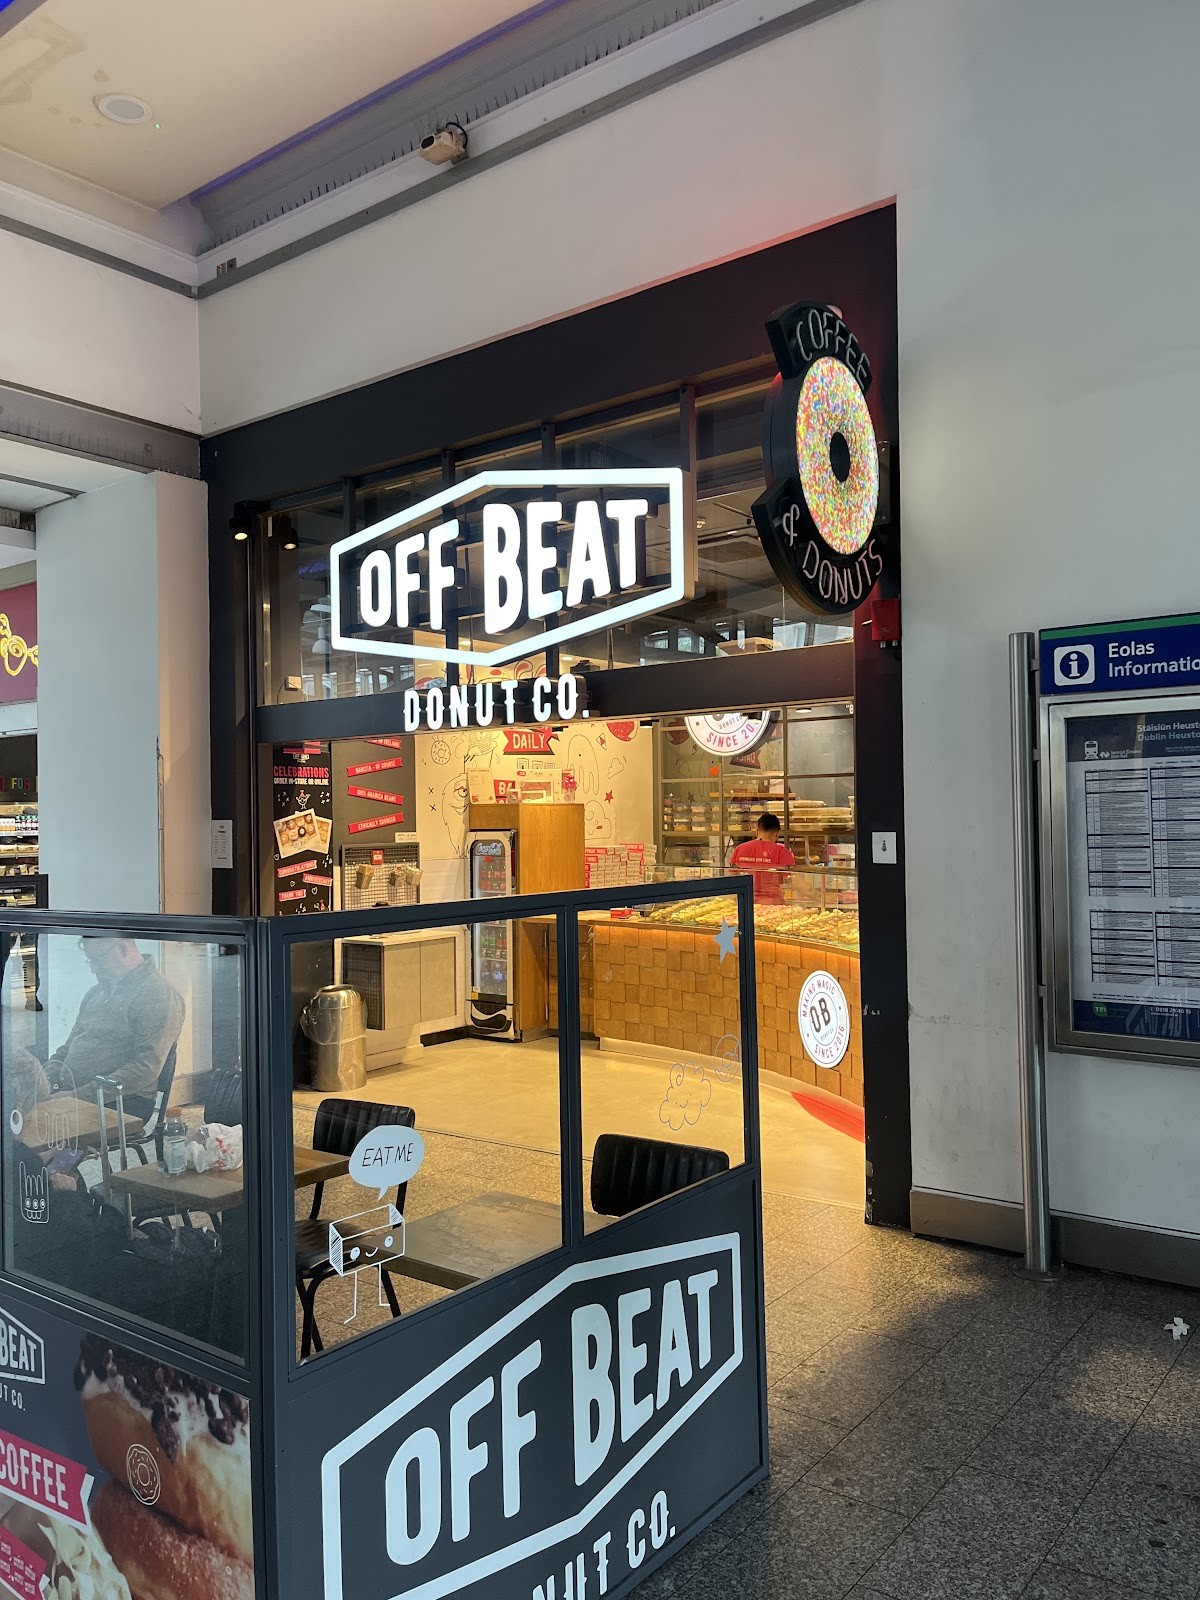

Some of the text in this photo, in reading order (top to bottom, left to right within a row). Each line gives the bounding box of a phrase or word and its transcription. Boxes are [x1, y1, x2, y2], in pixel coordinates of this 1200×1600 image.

[796, 309, 871, 391] COFFEE
[359, 498, 649, 635] OFF BEAT
[782, 504, 883, 605] & DONUTS
[1108, 641, 1155, 658] Eolas
[403, 673, 590, 732] DONUT CO.
[706, 723, 755, 748] SINCE 20
[1137, 733, 1167, 741] Dublin
[1173, 722, 1200, 730] Heust
[512, 733, 546, 749] DAILY
[273, 766, 329, 778] CELEBRATIONS
[817, 979, 836, 995] MAGIC
[809, 997, 831, 1033] OB
[814, 1044, 834, 1059] SINCE
[361, 1143, 414, 1167] EAT ME
[11, 1389, 26, 1412] CO.
[385, 1269, 719, 1566] OFF BEAT
[0, 1438, 69, 1510] COFFEE
[626, 1490, 676, 1568] CO.
